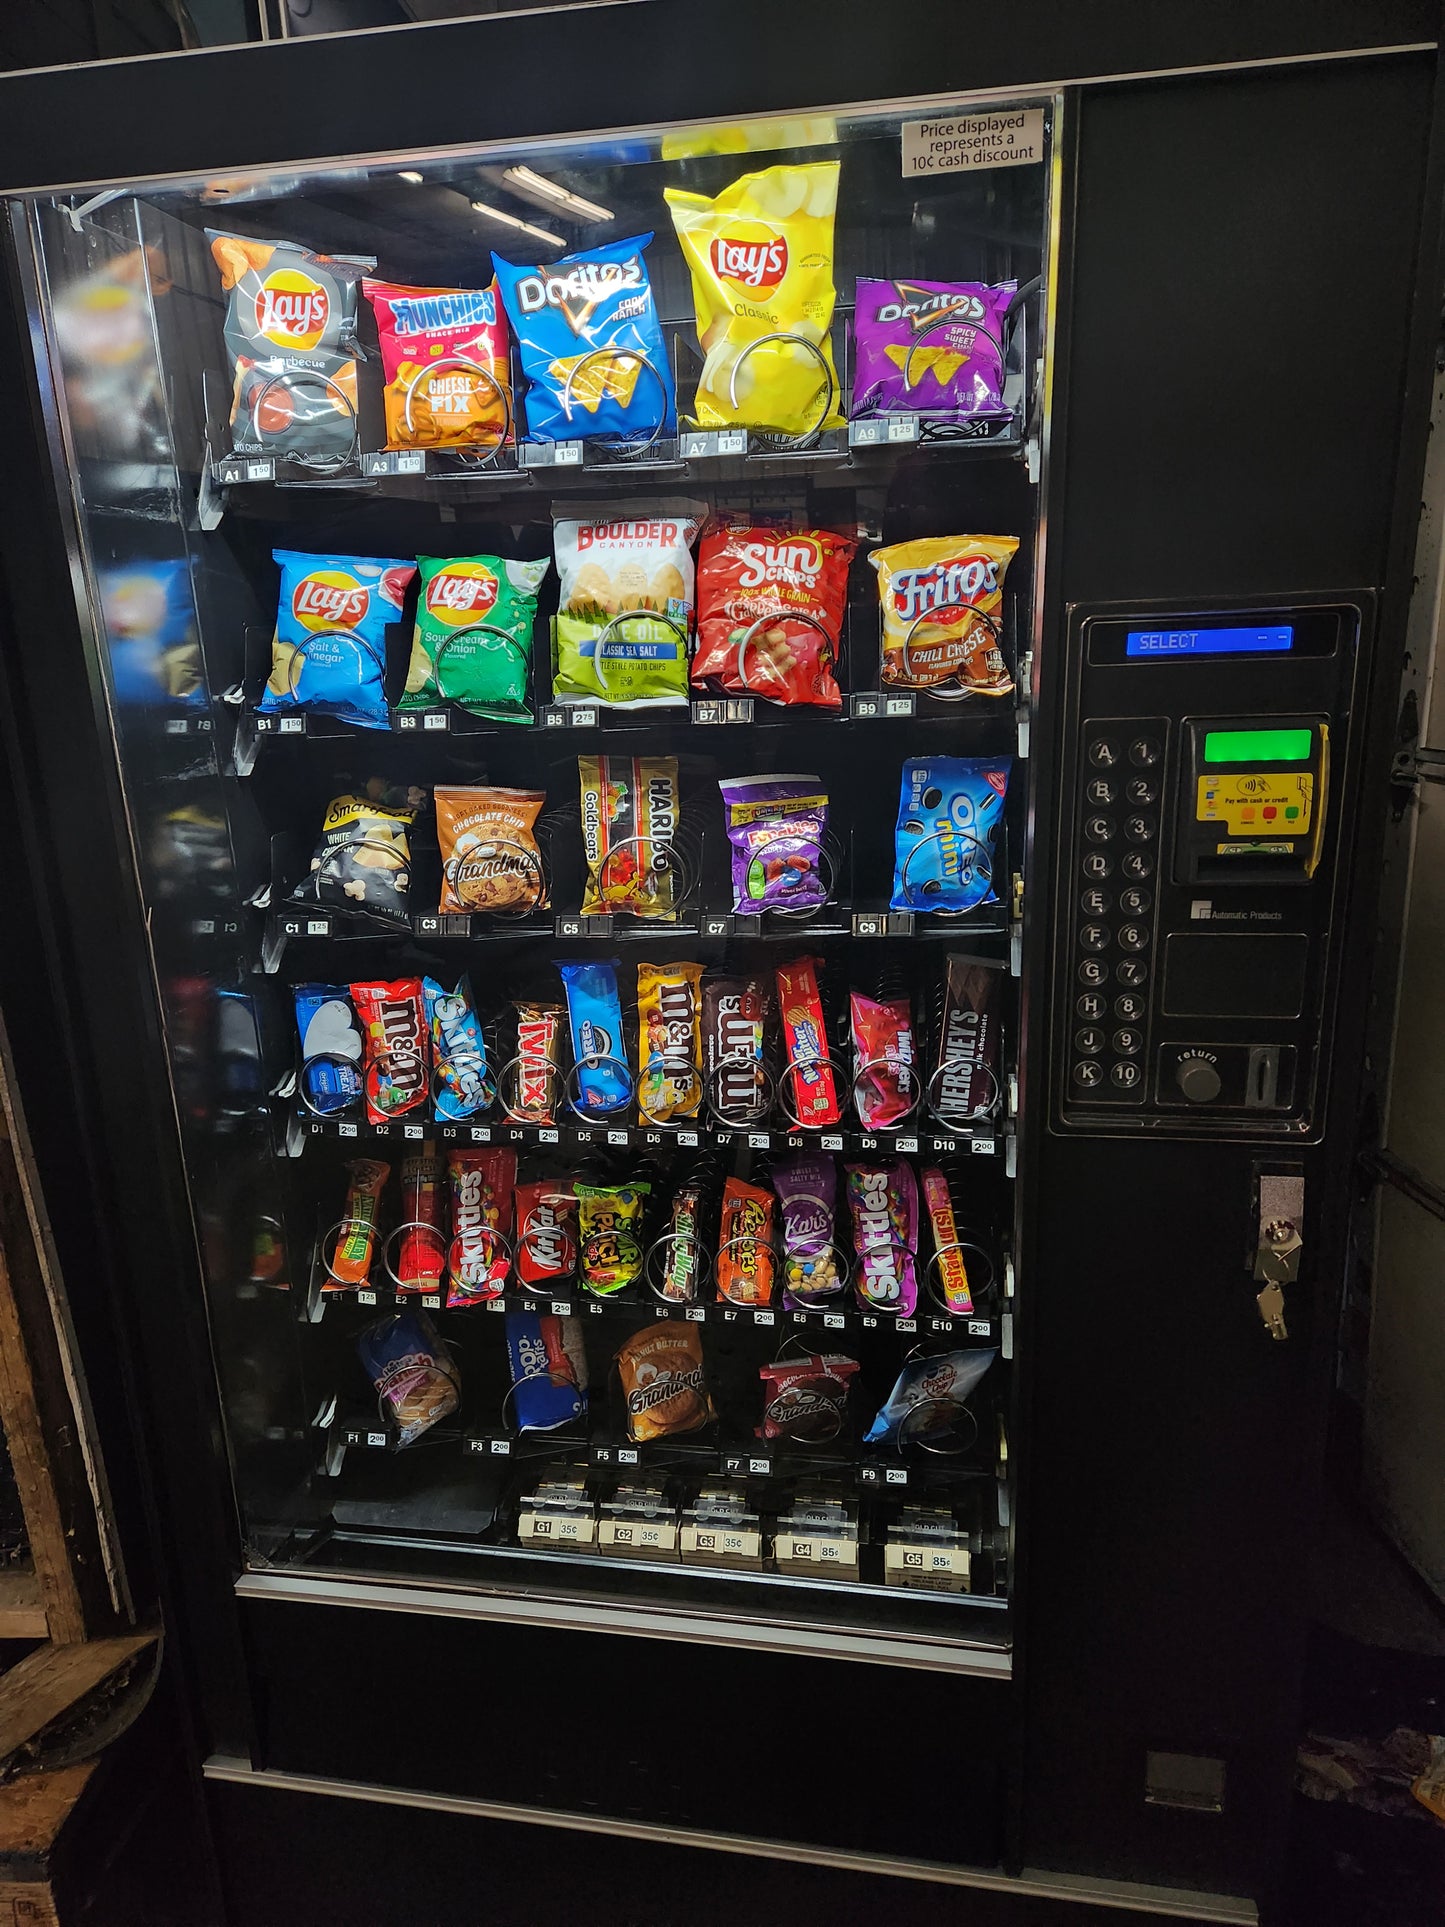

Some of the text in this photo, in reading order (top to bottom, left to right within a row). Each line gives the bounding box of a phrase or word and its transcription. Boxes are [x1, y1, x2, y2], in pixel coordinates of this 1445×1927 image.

[920, 114, 1025, 138] Price displayed
[930, 134, 1014, 154] represents a
[912, 146, 1034, 170] 10¢ cash discount
[717, 238, 784, 287] Lay's
[518, 255, 641, 314] Doritos
[262, 289, 326, 336] Lay's
[389, 291, 496, 335] MUNCHIES
[612, 304, 646, 322] RANCH
[878, 292, 986, 322] Doritos
[734, 304, 780, 324] Classic
[426, 330, 452, 339] SNACK
[950, 327, 977, 338] SPICY
[944, 334, 976, 346] SWEET
[270, 356, 326, 369] Barbecue
[428, 377, 472, 395] CHEESE
[431, 395, 470, 413] FIX
[858, 428, 876, 440] A9
[690, 442, 707, 454] A7
[372, 461, 387, 472] A3
[226, 470, 239, 482] A1
[578, 522, 678, 552] BOULDER
[600, 541, 653, 549] CANYON
[738, 543, 823, 588] Sun
[765, 566, 816, 589] CHIPS
[430, 575, 495, 610] Lay's
[891, 560, 999, 619] Fritos
[296, 582, 368, 621] Lay's
[786, 590, 812, 603] GRAIN
[637, 624, 663, 640] OIL
[424, 632, 488, 645] Sour Cream
[912, 626, 987, 663] CHILI CHEESE
[1140, 632, 1198, 650] SELECT
[308, 641, 340, 653] Salt &
[446, 642, 476, 654] Onion
[626, 646, 658, 656] SEA SALT
[306, 650, 344, 664] Vinegar
[628, 662, 648, 670] POTATO
[649, 662, 666, 672] CHIPS
[700, 710, 716, 720] B7
[858, 703, 877, 715] B9
[257, 718, 272, 730] B1
[400, 717, 416, 728] B3
[548, 714, 563, 726] B5
[1098, 746, 1112, 760] A
[1140, 744, 1148, 757] 1
[1096, 783, 1109, 796] B
[1136, 782, 1148, 796] 2
[328, 802, 415, 823] Smartfood
[452, 812, 526, 834] CHOCOLATE CHIP
[585, 790, 599, 862] Goldbears
[1094, 821, 1107, 834] C
[1134, 820, 1145, 833] 3
[326, 832, 352, 845] WHITE
[950, 794, 979, 886] OREO
[936, 820, 960, 876] mini
[443, 850, 541, 886] Grandma's
[1093, 858, 1105, 871] D
[1132, 856, 1142, 870] 4
[1092, 894, 1102, 906] E
[1130, 894, 1140, 906] 5
[1212, 911, 1282, 920] Automatic Products
[285, 924, 299, 934] C1
[422, 919, 437, 930] C3
[564, 923, 579, 934] C5
[708, 923, 725, 934] C7
[860, 922, 877, 934] C9
[1090, 930, 1100, 942] F
[1128, 929, 1138, 942] 6
[1086, 964, 1100, 977] G
[1126, 964, 1136, 977] 7
[1085, 1000, 1097, 1012] H
[1124, 1000, 1134, 1012] 8
[978, 1014, 988, 1052] chocolate
[580, 1019, 599, 1070] OREO
[1084, 1034, 1094, 1046] J
[1122, 1034, 1132, 1046] 9
[434, 997, 486, 1108] Skittles
[1177, 1048, 1218, 1064] return
[940, 1009, 979, 1112] HERSHEY'S
[1082, 1067, 1095, 1079] K
[1117, 1068, 1135, 1080] 10
[312, 1124, 324, 1134] D1
[376, 1126, 390, 1134] D2
[444, 1128, 456, 1138] D3
[510, 1130, 524, 1140] D4
[578, 1132, 592, 1142] D5
[646, 1134, 661, 1143] D6
[717, 1134, 732, 1144] D7
[788, 1138, 804, 1147] D8
[862, 1138, 878, 1149] D9
[934, 1140, 956, 1150] D10
[784, 1210, 828, 1242] Kar's
[740, 1198, 766, 1277] Reese's
[860, 1172, 901, 1300] Skittles
[332, 1292, 344, 1300] E1
[396, 1296, 408, 1304] E2
[524, 1302, 536, 1312] E4
[590, 1304, 603, 1314] E5
[656, 1307, 669, 1317] E6
[724, 1312, 738, 1320] E7
[794, 1314, 807, 1323] E8
[863, 1318, 878, 1327] E9
[932, 1320, 953, 1331] E10
[656, 1340, 689, 1350] BUTTER
[348, 1433, 359, 1443] F1
[471, 1442, 483, 1452] F3
[597, 1451, 610, 1460] F5
[726, 1458, 740, 1470] F7
[862, 1470, 876, 1480] F9
[536, 1522, 577, 1534] G1 35¢
[617, 1530, 658, 1542] G2 35¢
[700, 1536, 742, 1548] G3 35¢
[796, 1544, 839, 1558] G4 85¢
[906, 1554, 950, 1566] G5 85¢
